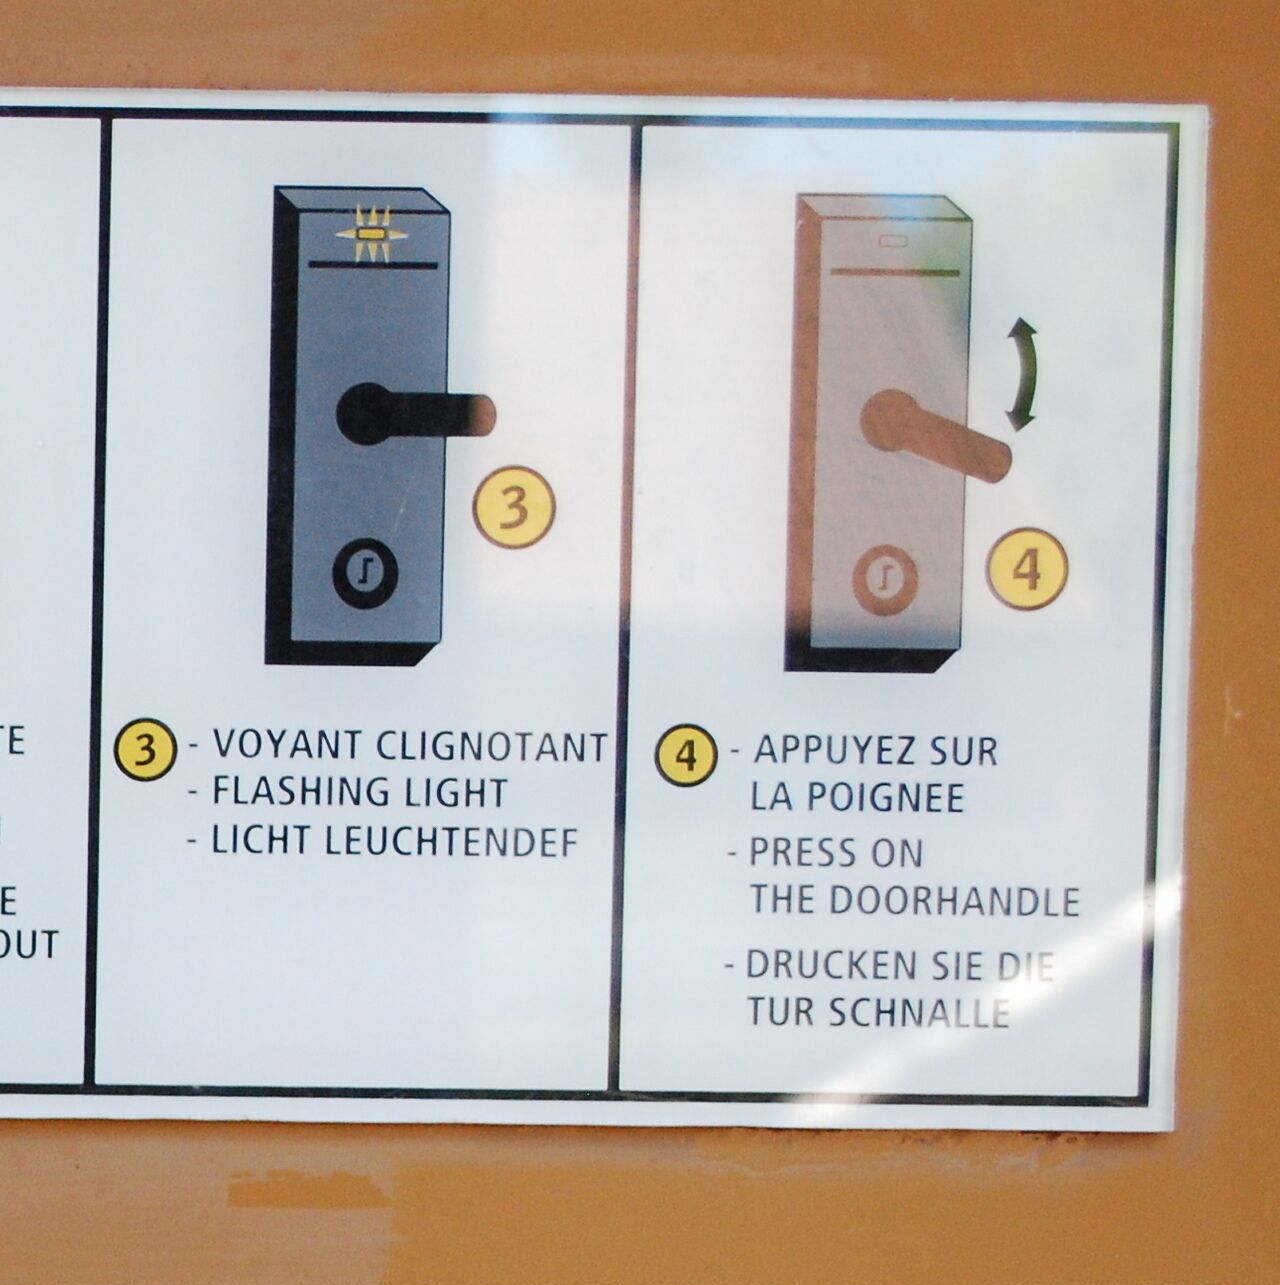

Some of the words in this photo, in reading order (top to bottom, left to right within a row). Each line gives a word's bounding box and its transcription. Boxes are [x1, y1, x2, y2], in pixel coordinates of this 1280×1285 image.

[499, 485, 528, 530] 3
[1013, 547, 1041, 591] 4
[135, 733, 156, 766] 3
[213, 728, 362, 759] VOYANT
[377, 730, 608, 762] CLIGNOTANT
[675, 739, 697, 772] 4
[754, 734, 915, 765] APPUYEZ
[930, 736, 997, 766] SUR
[214, 775, 388, 807] FLASHING
[406, 777, 508, 807] LIGHT
[752, 781, 793, 811] LA
[808, 781, 964, 813] POIGNEE
[213, 824, 311, 854] LICHT
[326, 825, 577, 857] LEUCHTENDEF
[751, 837, 856, 867] PRESS
[871, 838, 922, 868] ON
[750, 884, 815, 914] THE
[830, 885, 1079, 917] DOORHANDLE
[747, 949, 916, 980] DRUCKEN
[932, 951, 983, 981] SIE
[998, 952, 1053, 981] DIE
[747, 996, 813, 1026] TUR
[830, 997, 1008, 1028] SCHNALLE
